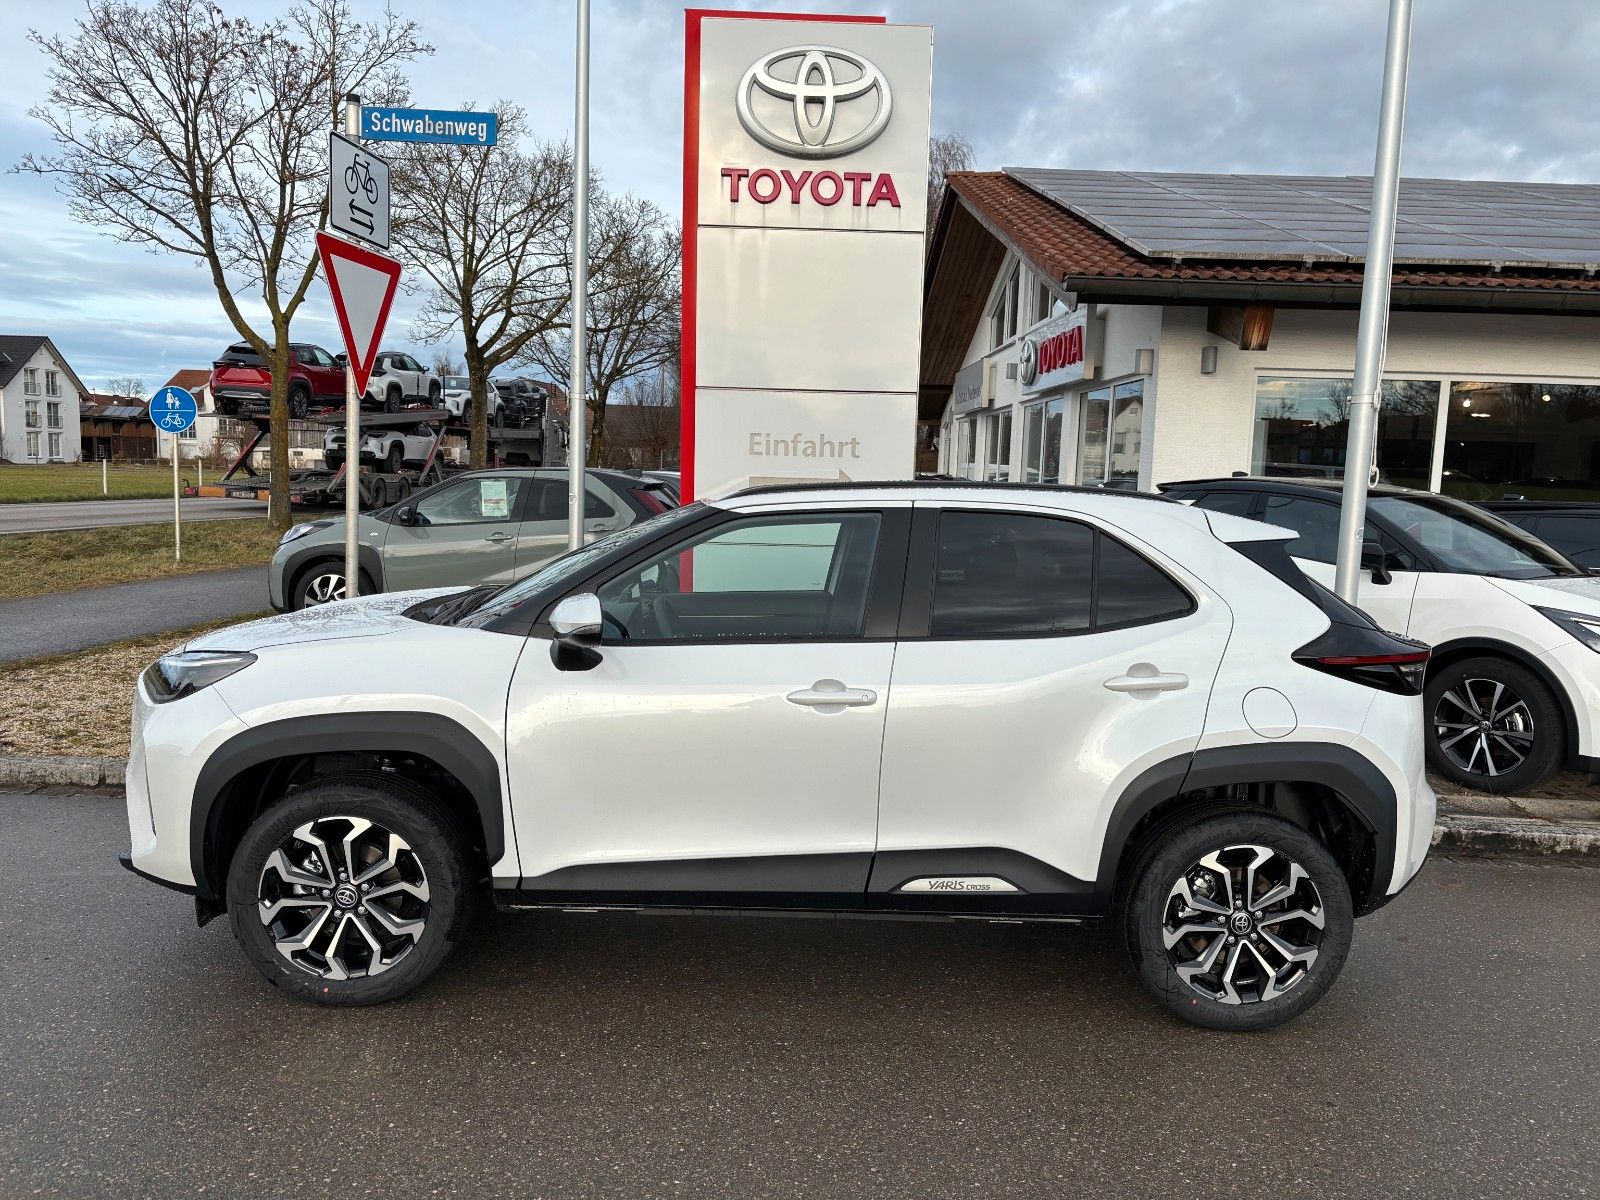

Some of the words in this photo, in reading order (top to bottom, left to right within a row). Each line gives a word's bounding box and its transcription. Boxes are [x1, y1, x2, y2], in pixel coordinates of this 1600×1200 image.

[371, 112, 487, 141] Schwabenweg
[721, 167, 901, 208] TOYOTA
[1039, 325, 1083, 375] TOYOTA
[749, 432, 861, 459] Einfahrt
